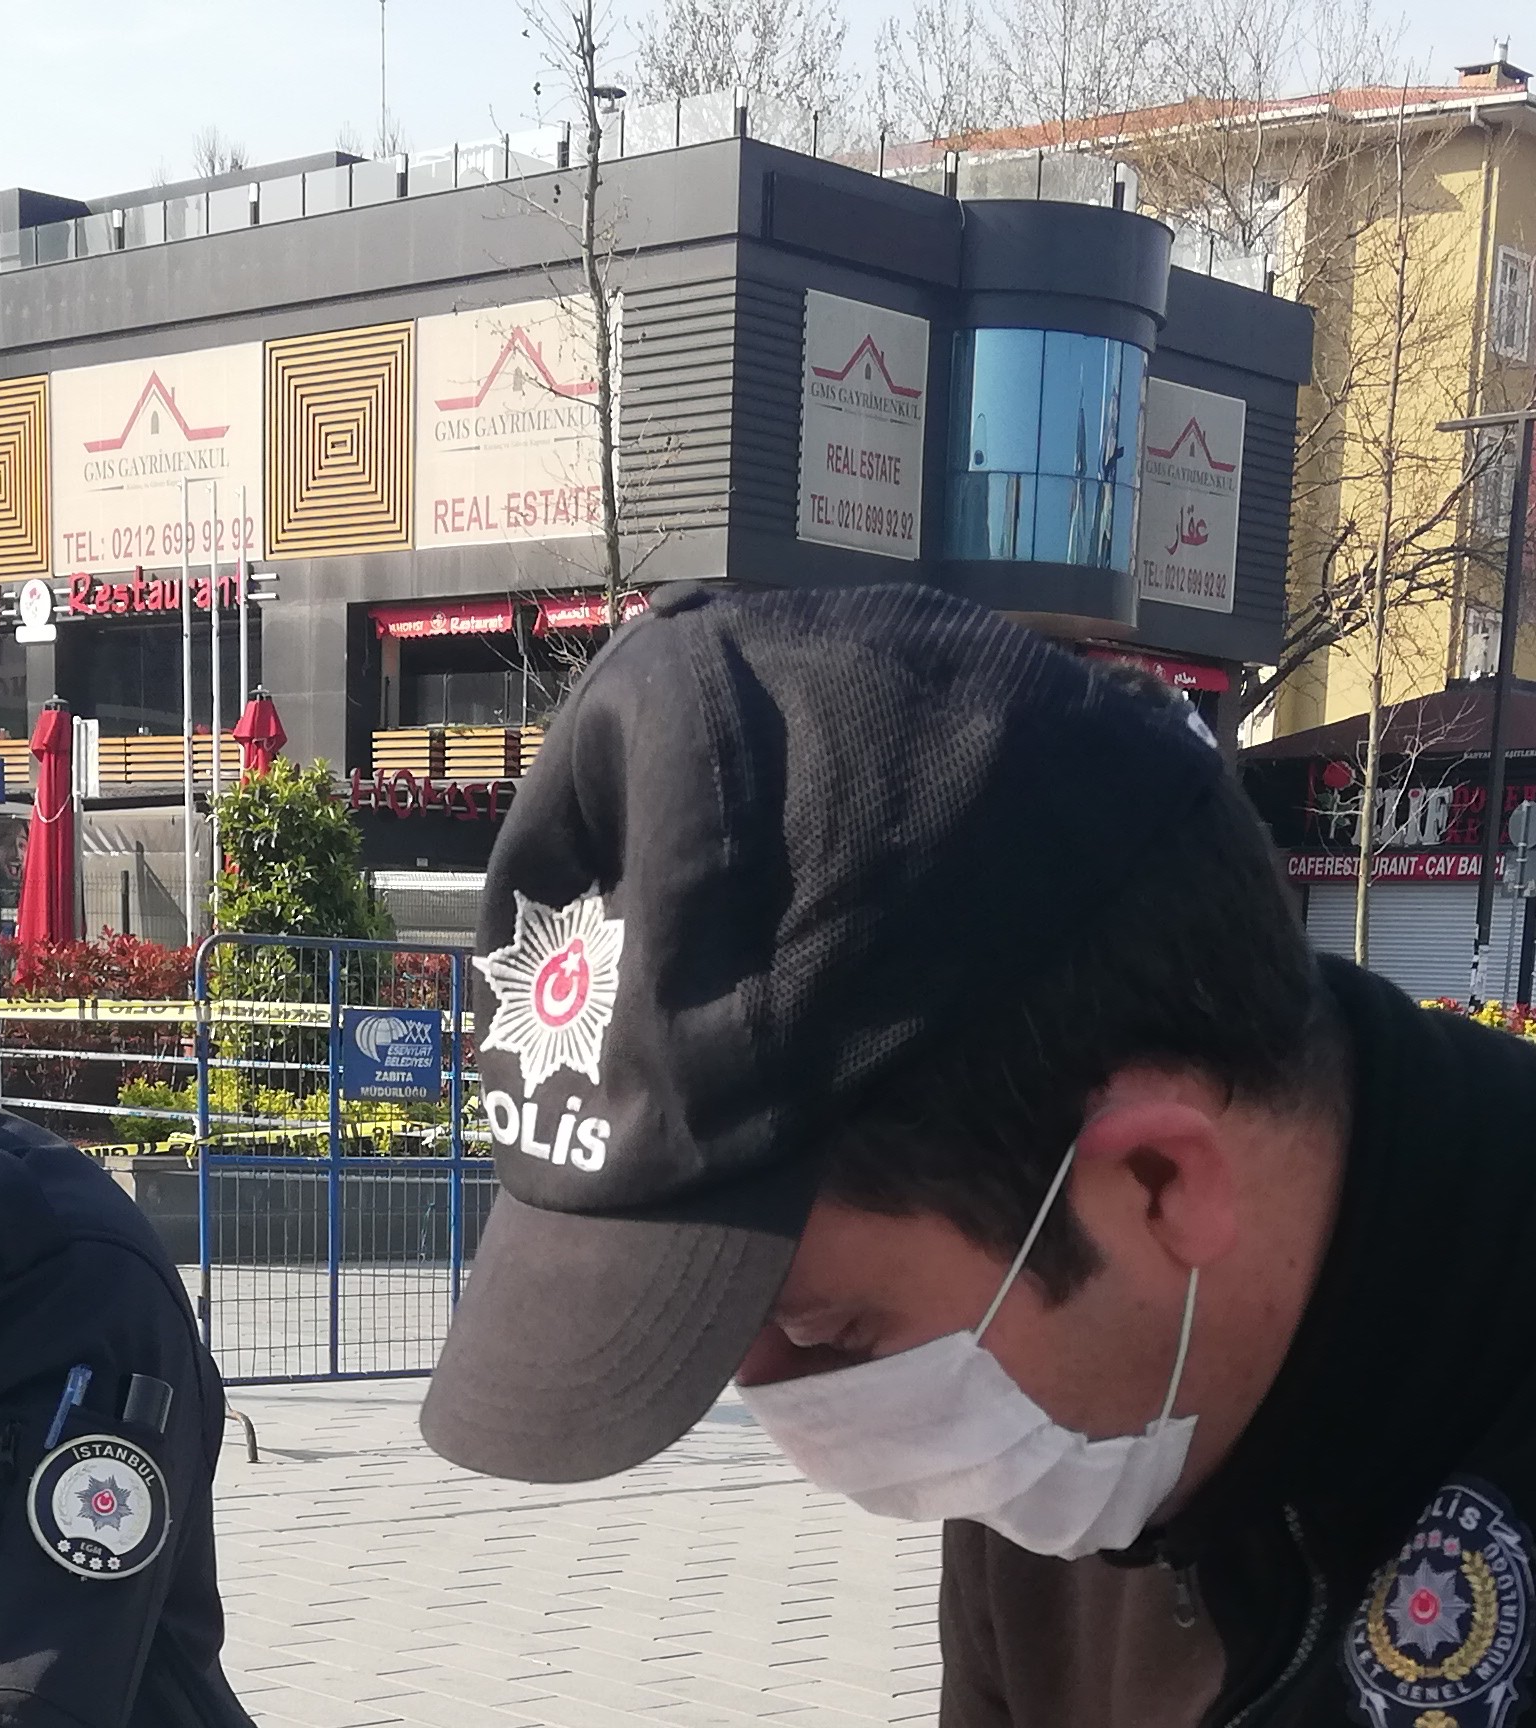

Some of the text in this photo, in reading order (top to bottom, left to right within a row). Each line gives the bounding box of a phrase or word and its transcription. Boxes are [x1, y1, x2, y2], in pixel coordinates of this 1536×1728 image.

[810, 382, 836, 400] GMS
[435, 416, 471, 442] GMS
[83, 445, 231, 483] GMS GAYRİMENKUL
[826, 443, 902, 487] REAL ESTATE
[435, 485, 602, 534] REAL ESTATE
[810, 493, 915, 541] TEL: 0212 699 92 92
[1165, 503, 1210, 556] عقار
[63, 530, 107, 566] TEL:
[112, 524, 156, 560] 0212
[202, 518, 225, 553] 92
[231, 515, 255, 551] 92
[1165, 561, 1186, 593] 0212
[1202, 569, 1215, 598] 92
[1214, 572, 1227, 600] 92
[386, 1043, 434, 1057] ESENYURT
[375, 1070, 414, 1082] ZABITA
[71, 1443, 157, 1488] İSTANBUL
